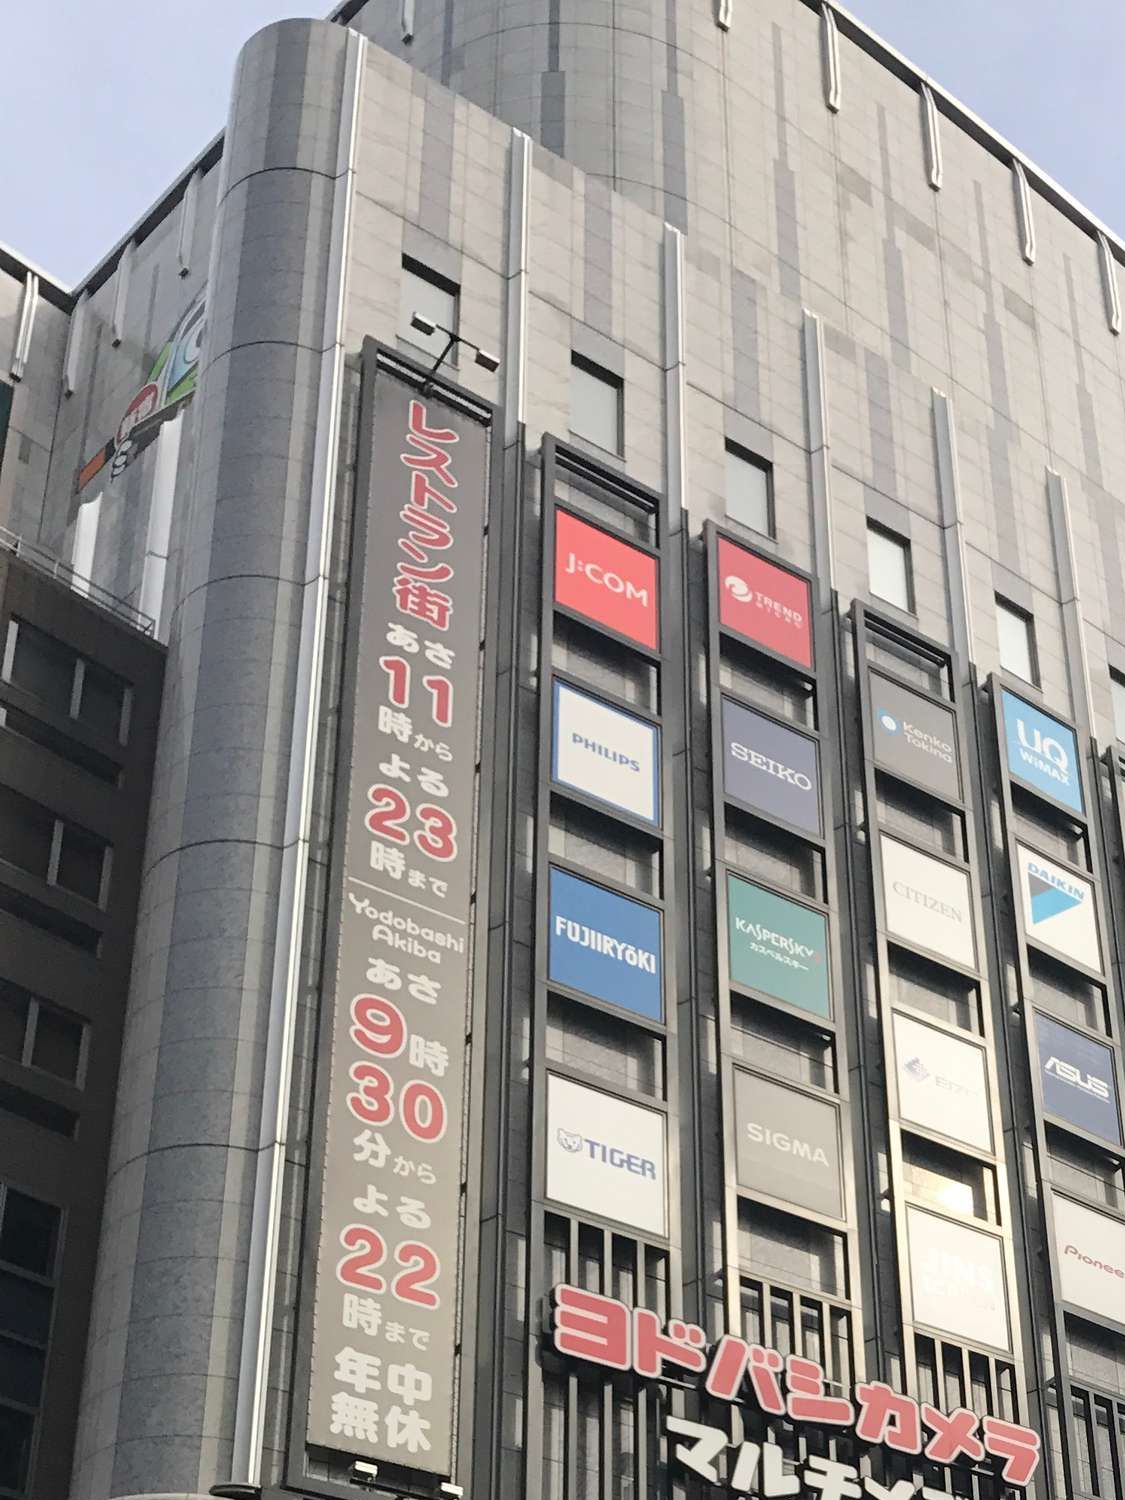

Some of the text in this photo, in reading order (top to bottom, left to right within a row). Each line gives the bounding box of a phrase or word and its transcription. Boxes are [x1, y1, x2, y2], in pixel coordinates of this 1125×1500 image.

[394, 400, 461, 632] レストラン街
[566, 552, 648, 608] J:COM
[755, 592, 802, 624] TREND
[387, 622, 456, 671] あさ
[379, 655, 454, 728] 11
[378, 705, 454, 762] 時から
[571, 732, 641, 773] PHILIPS
[904, 721, 953, 753] Kenko
[904, 732, 953, 763] Tokina
[1017, 719, 1070, 774] UQ
[378, 753, 449, 797] よる
[731, 742, 812, 790] SEIKO
[1019, 749, 1071, 786] WiMAX
[365, 783, 457, 863] 23
[370, 841, 448, 898] 時まで
[1027, 862, 1085, 901] DAIKIN
[349, 892, 465, 954] Yodobashi
[892, 880, 963, 925] CITIZEN
[371, 924, 441, 965] Akiba
[735, 917, 816, 958] KASPERSKY
[749, 941, 809, 970] カスペルスキー
[367, 956, 441, 1005] あさ
[934, 1074, 982, 1098] EIZ
[1043, 1055, 1111, 1099] ASUS
[346, 1060, 447, 1144] 30
[352, 1132, 436, 1185] 分から
[584, 1137, 657, 1181] TIGER
[747, 1123, 830, 1167] SIGMA
[353, 1184, 432, 1230] よる
[337, 1223, 441, 1310] 22
[343, 1294, 430, 1351] 時まで
[554, 1283, 1041, 1489] ヨドバシカメラ
